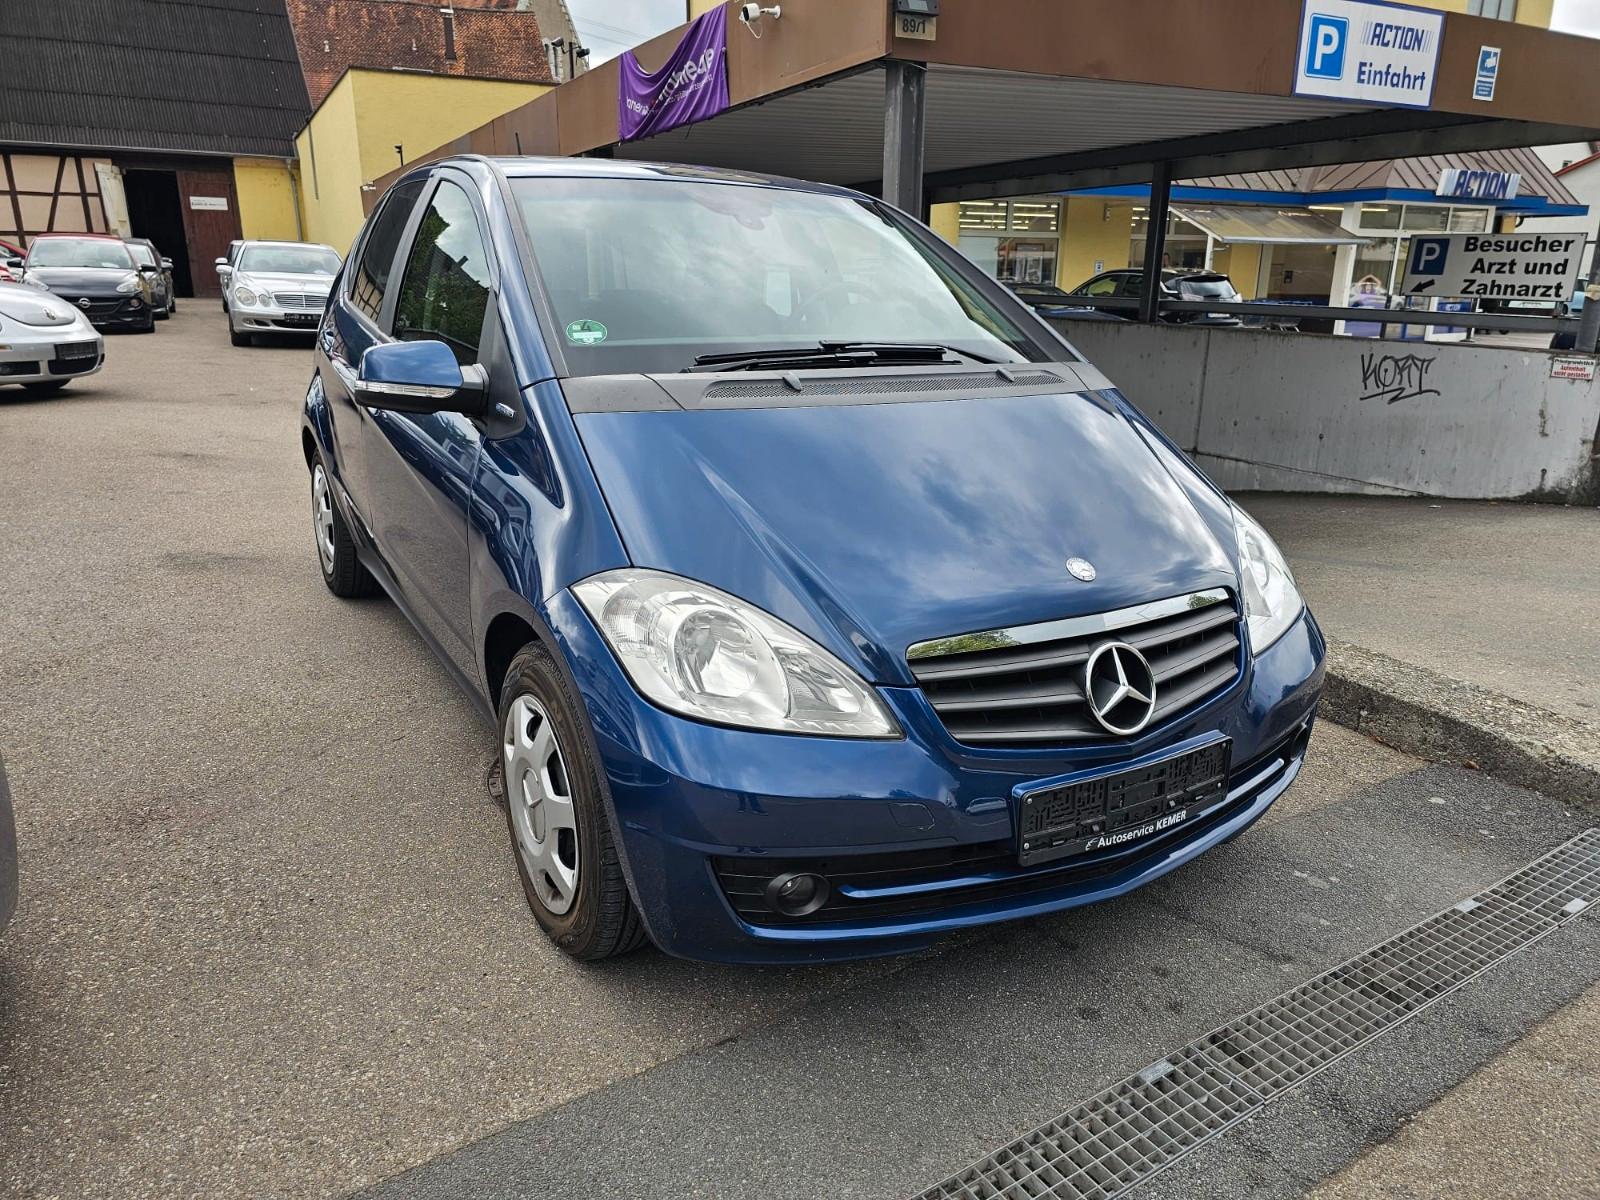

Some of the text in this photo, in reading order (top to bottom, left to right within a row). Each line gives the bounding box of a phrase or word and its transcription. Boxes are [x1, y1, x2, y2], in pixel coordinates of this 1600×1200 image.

[902, 18, 926, 34] 89/1
[1370, 22, 1425, 52] ACTION
[1313, 24, 1340, 70] P
[1357, 61, 1426, 91] Einfahrt
[1453, 169, 1512, 199] ACTION
[1418, 242, 1441, 271] P
[1463, 235, 1575, 253] Besucher
[1469, 257, 1570, 276] Arzt und
[1460, 278, 1564, 298] Zahnarzt
[1097, 810, 1187, 848] Autoservice KEMER
